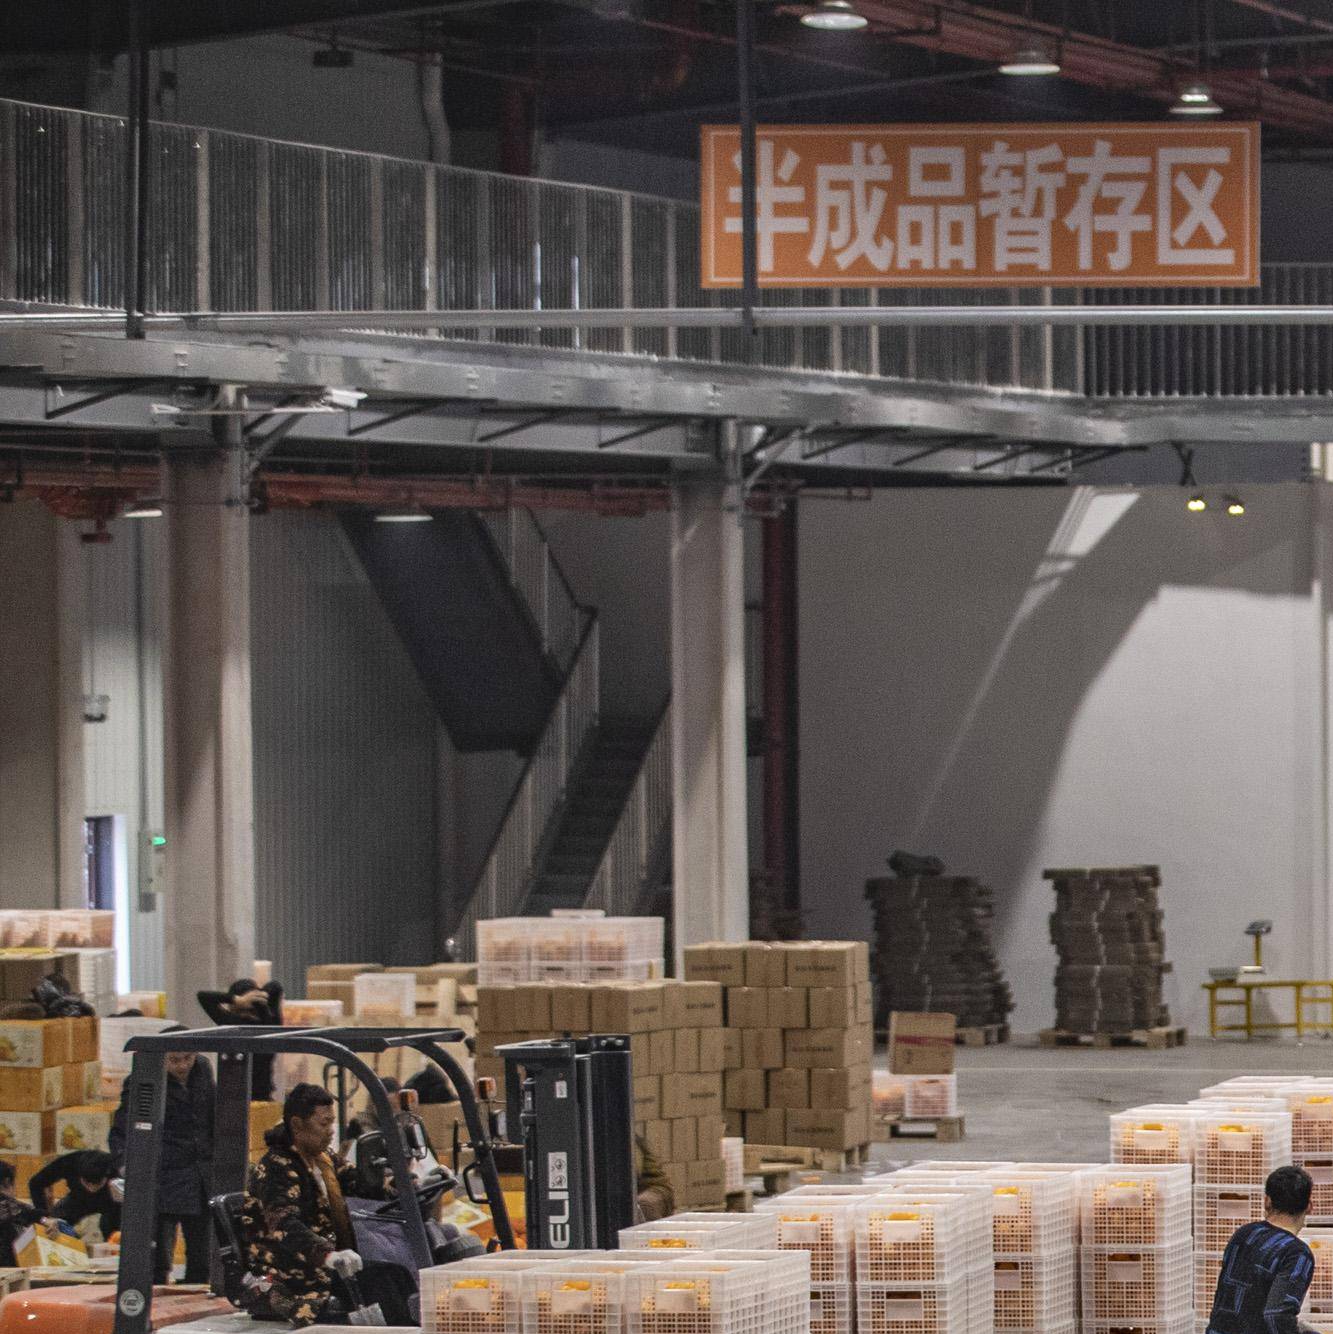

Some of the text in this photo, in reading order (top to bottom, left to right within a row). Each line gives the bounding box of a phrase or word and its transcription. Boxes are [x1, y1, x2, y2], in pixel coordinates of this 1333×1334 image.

[724, 139, 1236, 273] 半成品暂存区
